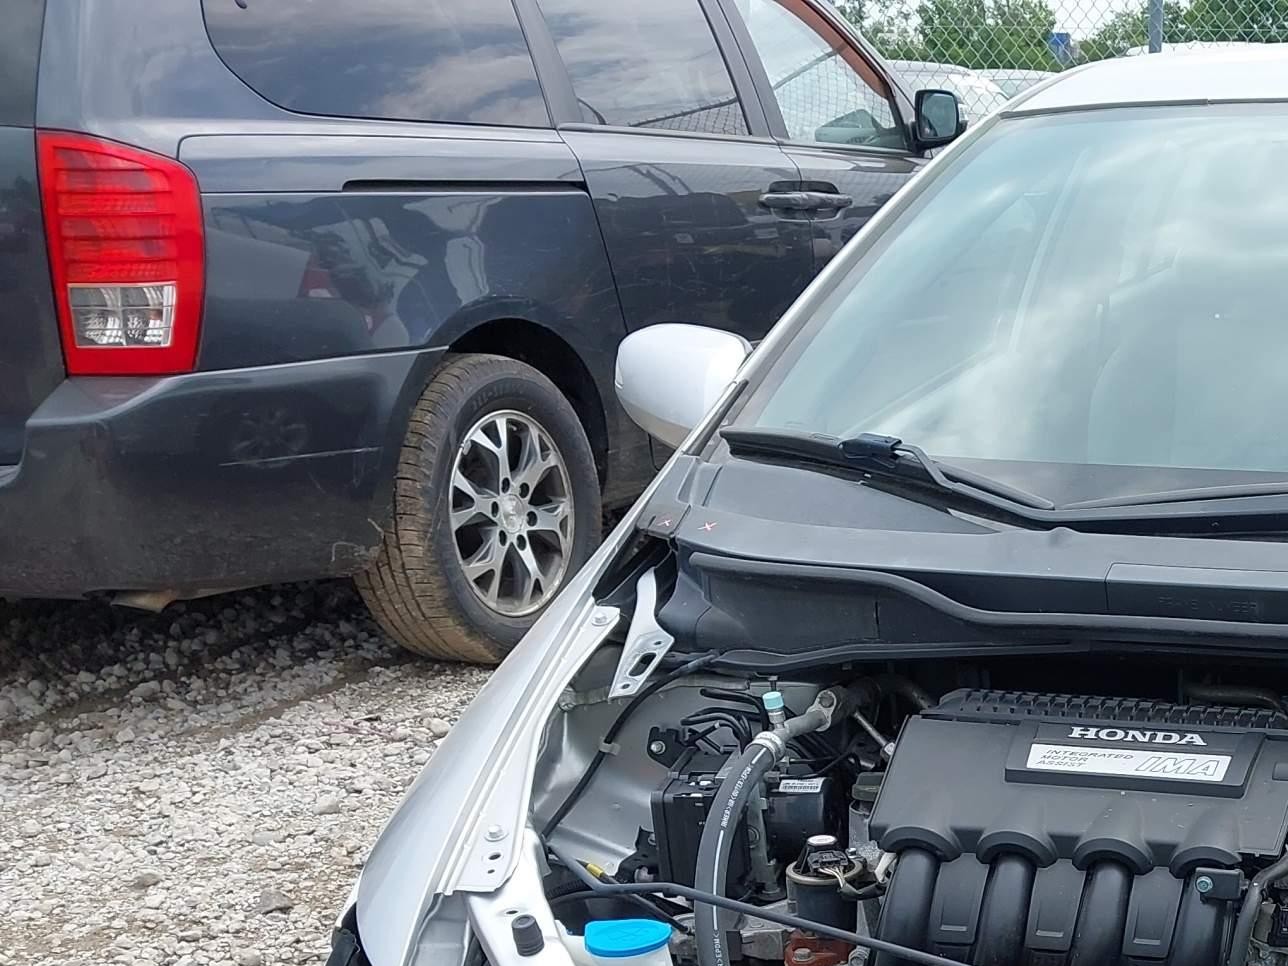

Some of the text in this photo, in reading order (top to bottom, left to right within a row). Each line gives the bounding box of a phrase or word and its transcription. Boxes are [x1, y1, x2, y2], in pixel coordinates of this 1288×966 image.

[1068, 726, 1208, 746] HONDA
[1040, 754, 1089, 762] MOTOR
[1046, 749, 1134, 760] INTEGRATED
[1135, 755, 1220, 777] IMA
